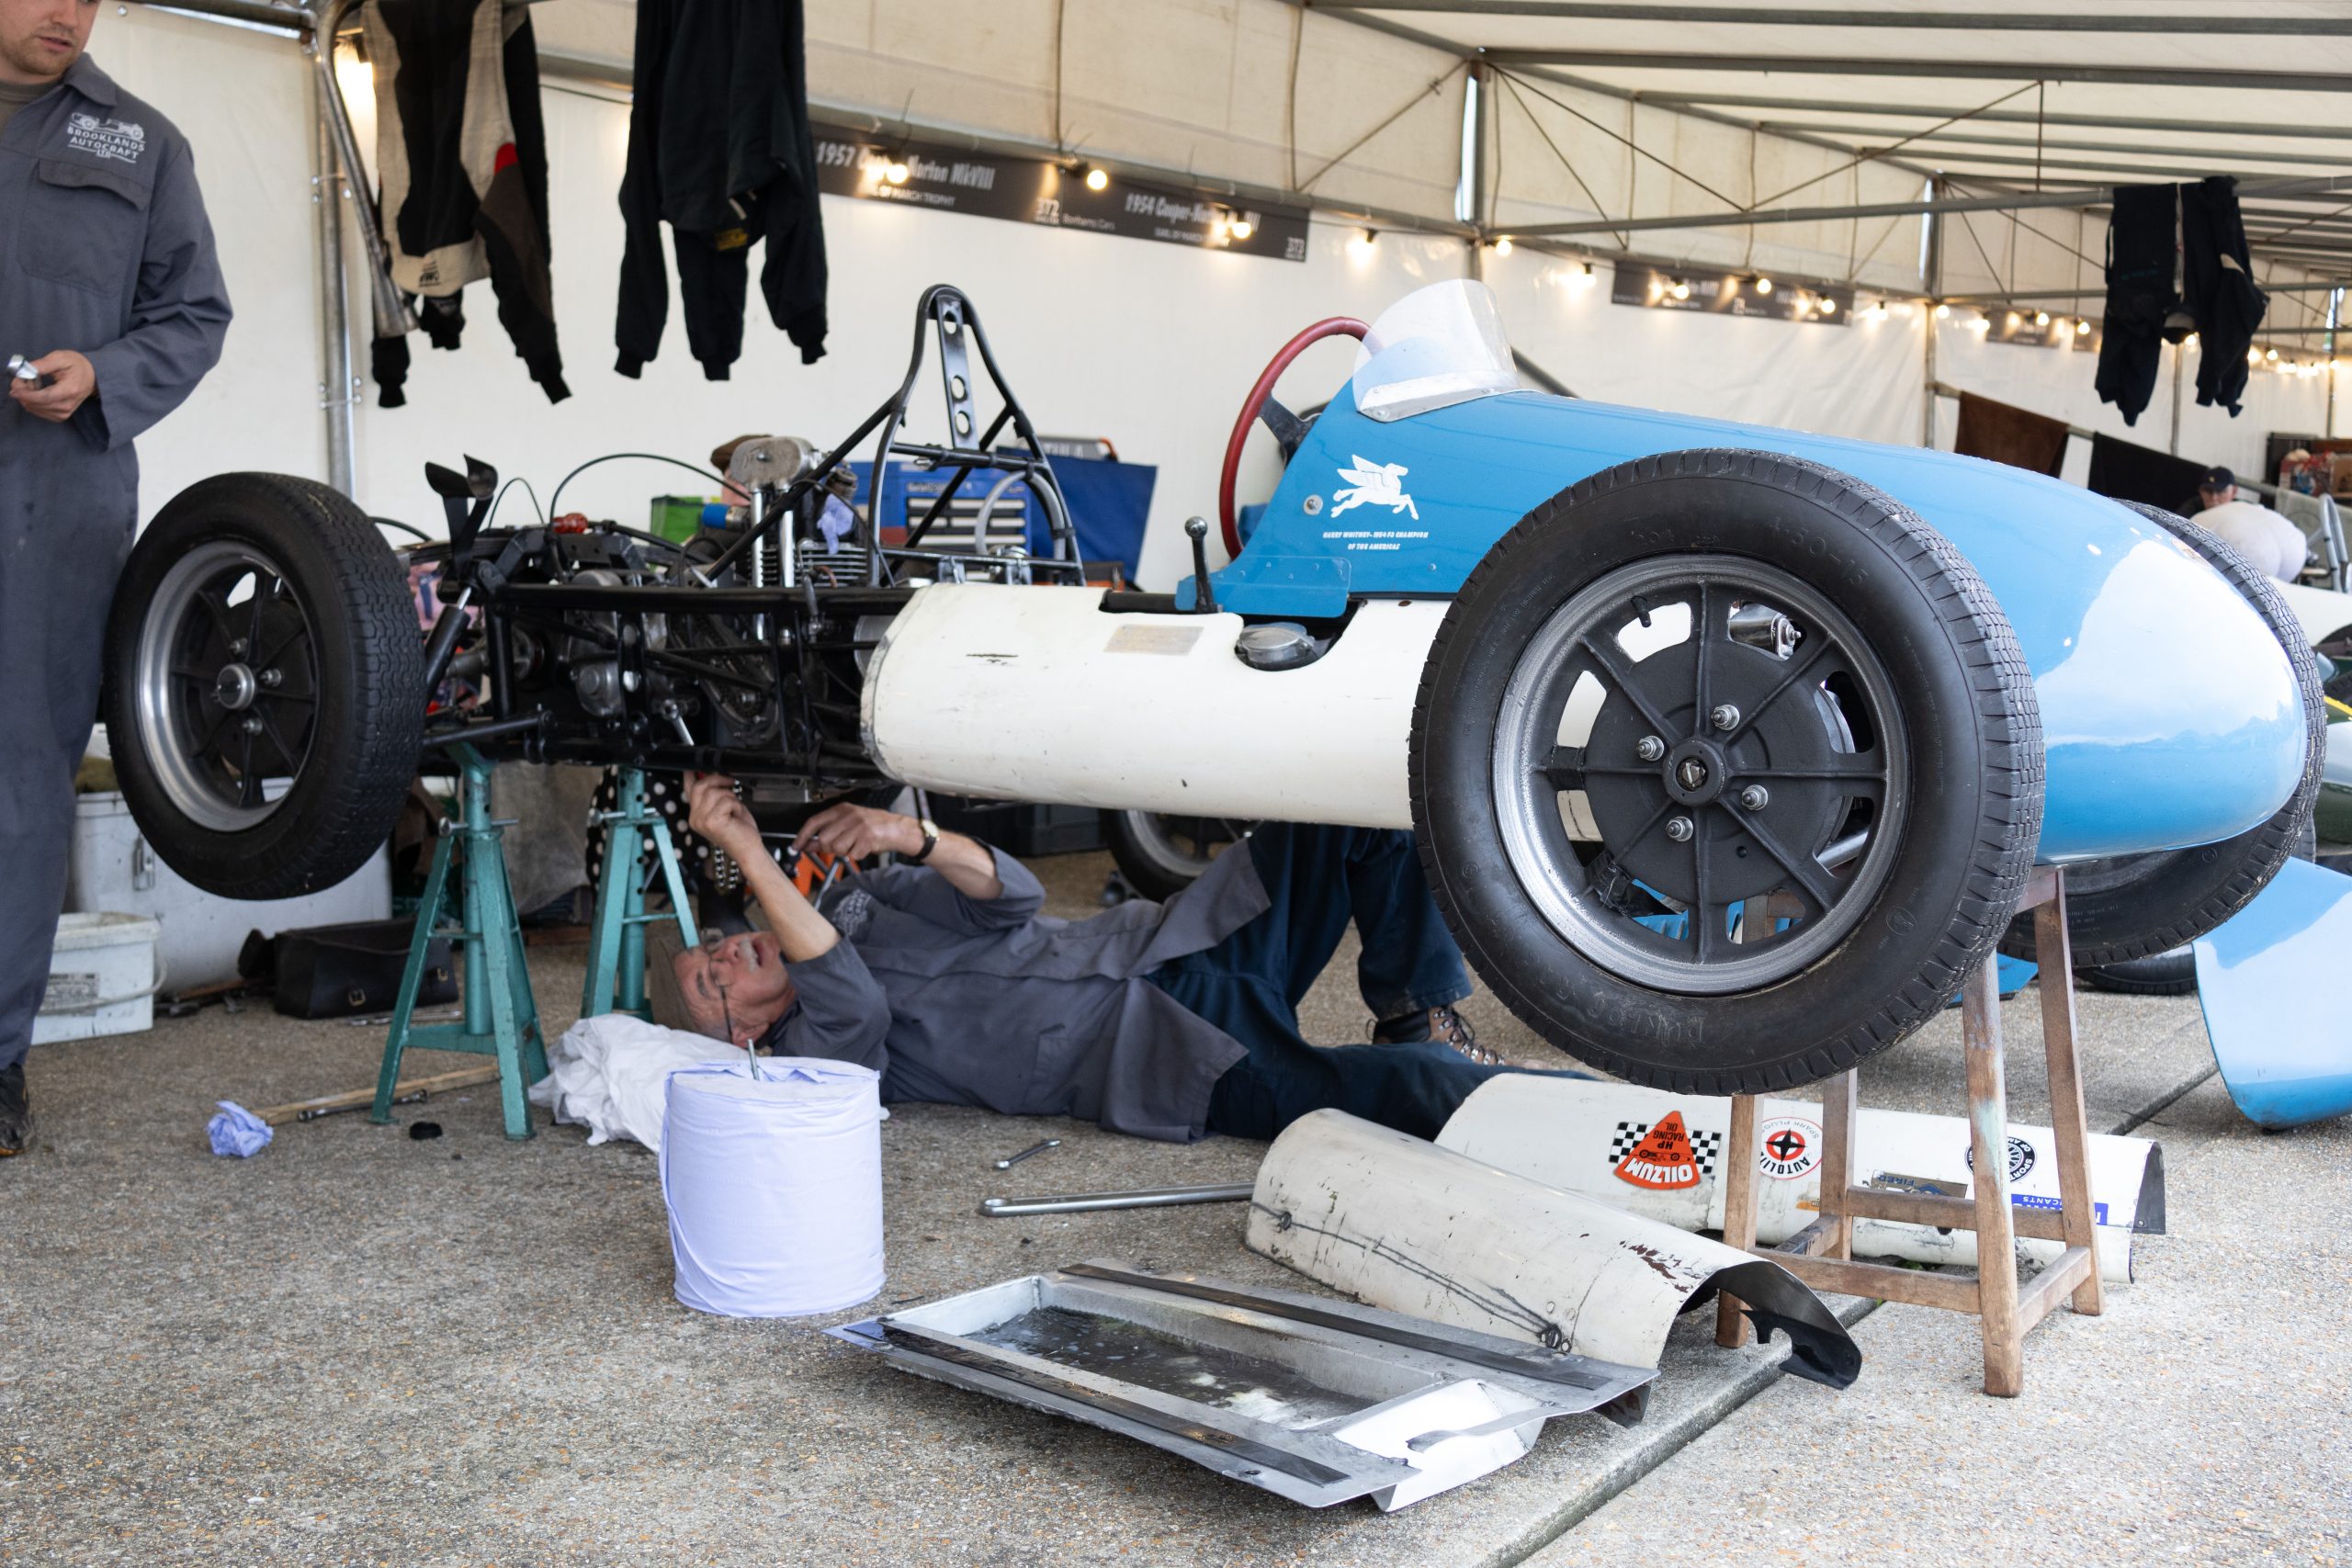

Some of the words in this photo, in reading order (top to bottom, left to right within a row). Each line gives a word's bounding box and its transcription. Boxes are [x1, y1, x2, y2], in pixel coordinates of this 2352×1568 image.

[67, 125, 145, 152] BROOKLANDS
[70, 136, 139, 159] AUTOCRAFT
[816, 141, 855, 167] 1957
[1125, 192, 1156, 216] 1954
[1323, 531, 1342, 539] HARRY
[1396, 531, 1429, 539] CHAMPION
[1665, 1122, 1679, 1132] OIL
[1762, 1120, 1791, 1134] PLUG
[1793, 1121, 1819, 1139] SPARK
[1653, 1130, 1685, 1142] RACING
[1657, 1141, 1674, 1150] HP
[2019, 1143, 2032, 1154] OF
[1623, 1157, 1693, 1184] OILZUM
[2009, 1157, 2032, 1180] SPORT
[2022, 1196, 2062, 1205] CANTS
